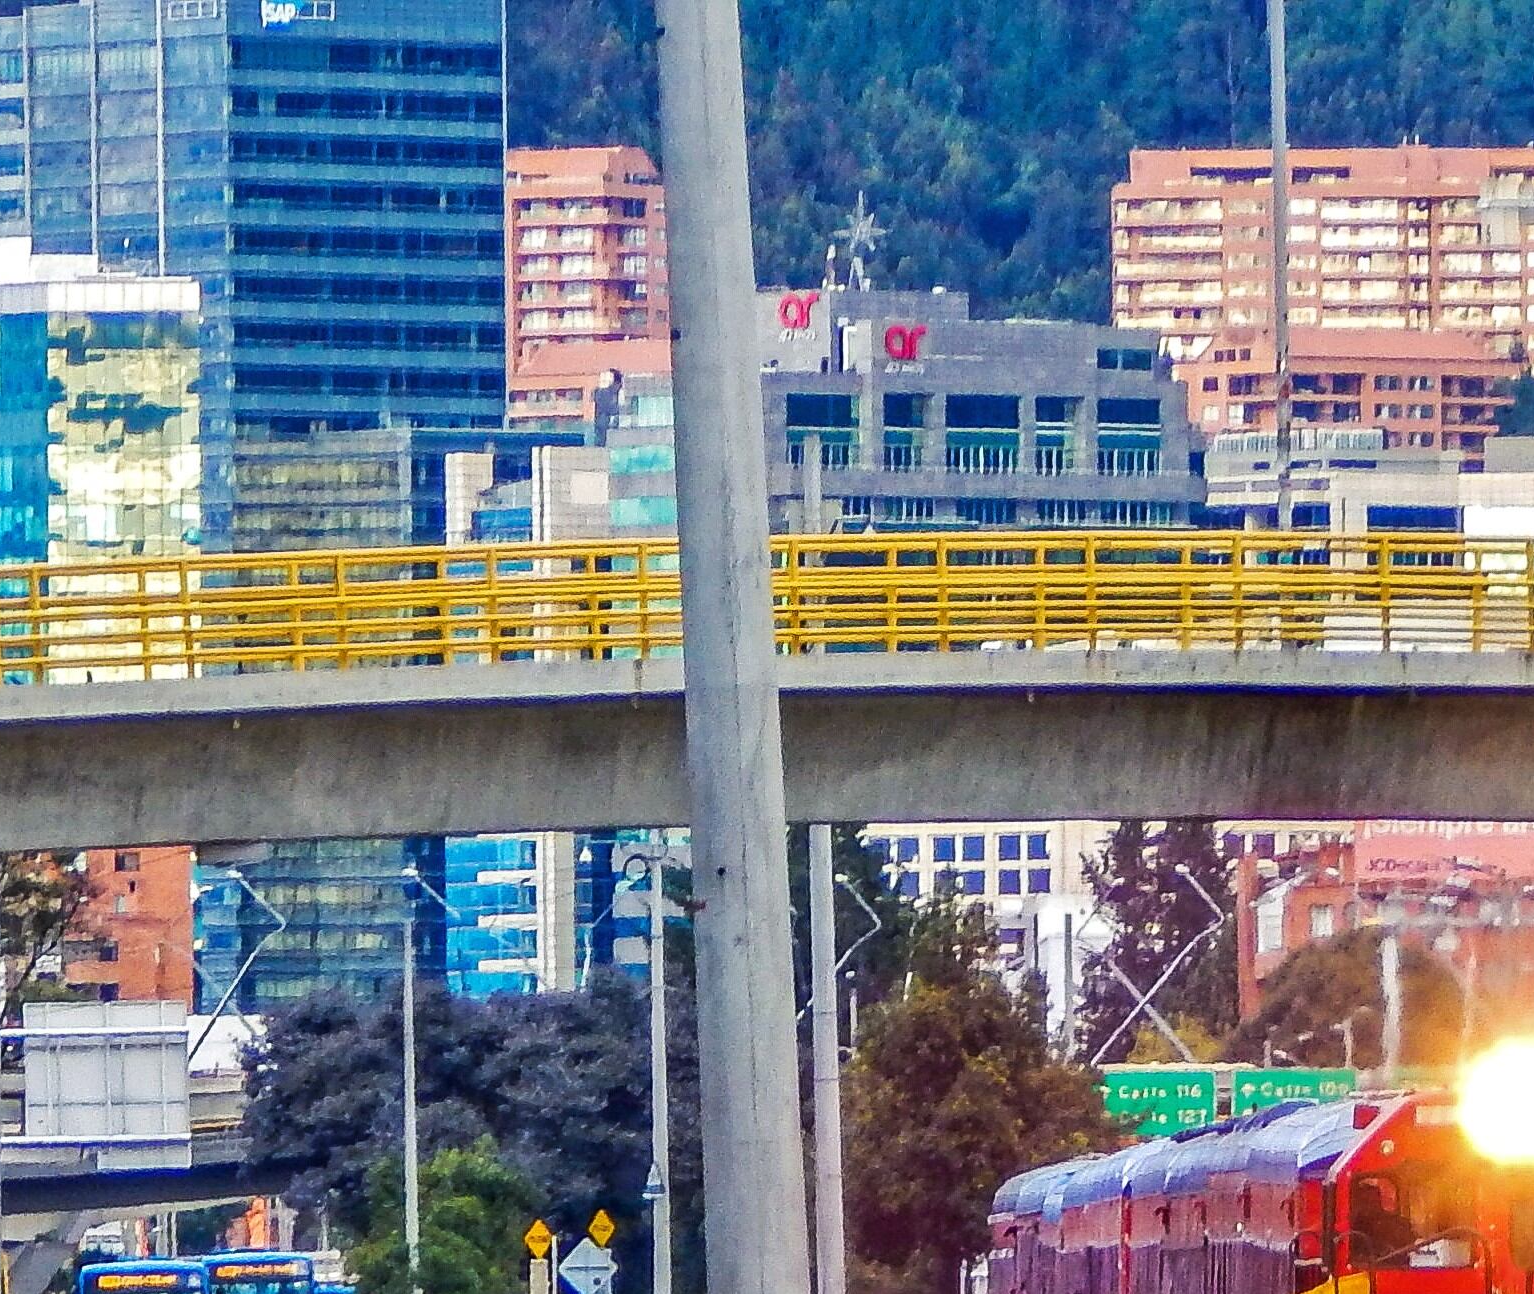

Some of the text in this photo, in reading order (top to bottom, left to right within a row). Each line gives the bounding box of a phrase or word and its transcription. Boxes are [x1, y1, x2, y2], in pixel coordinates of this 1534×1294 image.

[266, 2, 297, 23] SAP
[1118, 1084, 1201, 1099] Calle 116
